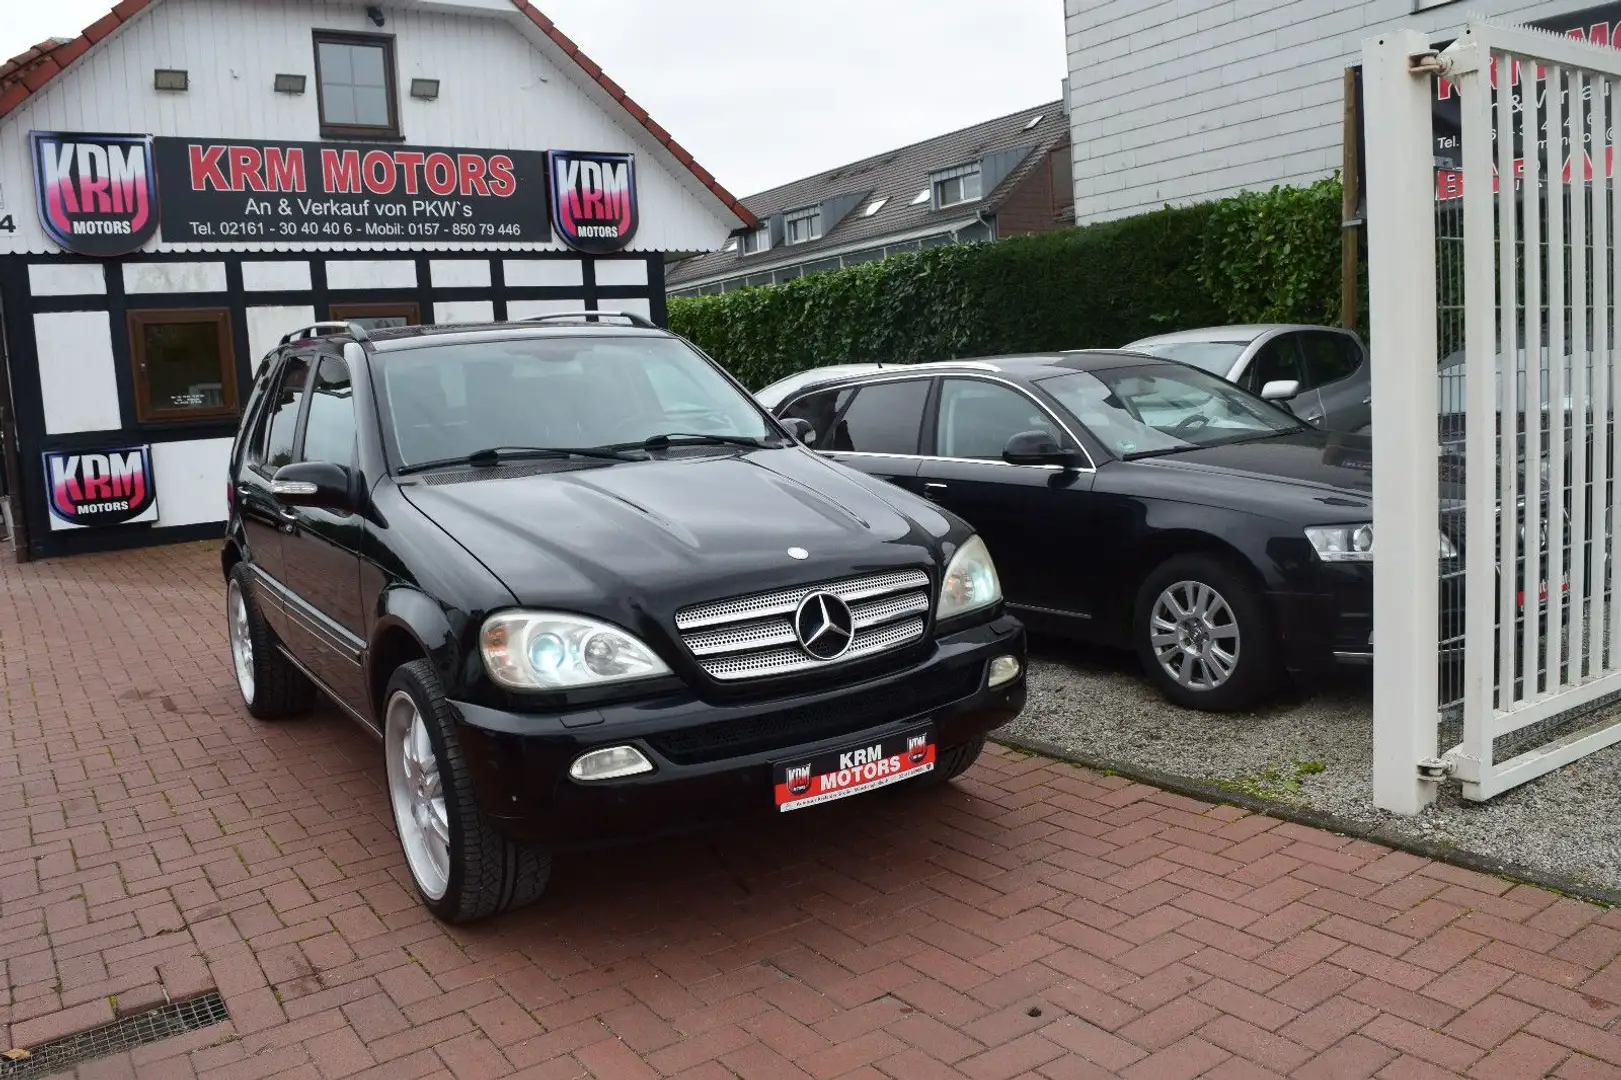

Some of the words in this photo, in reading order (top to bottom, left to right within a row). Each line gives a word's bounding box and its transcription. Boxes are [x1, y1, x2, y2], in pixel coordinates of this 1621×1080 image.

[1437, 136, 1460, 149] Tel.
[188, 144, 307, 193] KRM
[320, 148, 517, 198] MOTORS
[43, 142, 149, 230] KRM
[557, 159, 632, 234] KRM
[245, 198, 272, 216] An
[278, 199, 293, 216] &
[298, 198, 370, 217] Verkauf
[375, 204, 407, 217] von
[73, 220, 131, 234] MOTORS
[189, 221, 216, 235] Tel.
[220, 222, 264, 235] 02161
[279, 222, 297, 235] 30
[300, 222, 318, 235] 40
[322, 222, 341, 235] 40
[343, 222, 353, 235] 6
[365, 222, 404, 236] Mobil:
[408, 223, 440, 236] 0157
[452, 223, 476, 236] 850
[479, 223, 495, 236] 79
[498, 223, 521, 236] 446
[577, 225, 618, 238] MOTORS
[53, 452, 145, 514] KRM
[77, 501, 129, 515] MOTORS
[839, 744, 882, 770] KRM
[820, 755, 901, 791] MOTORS
